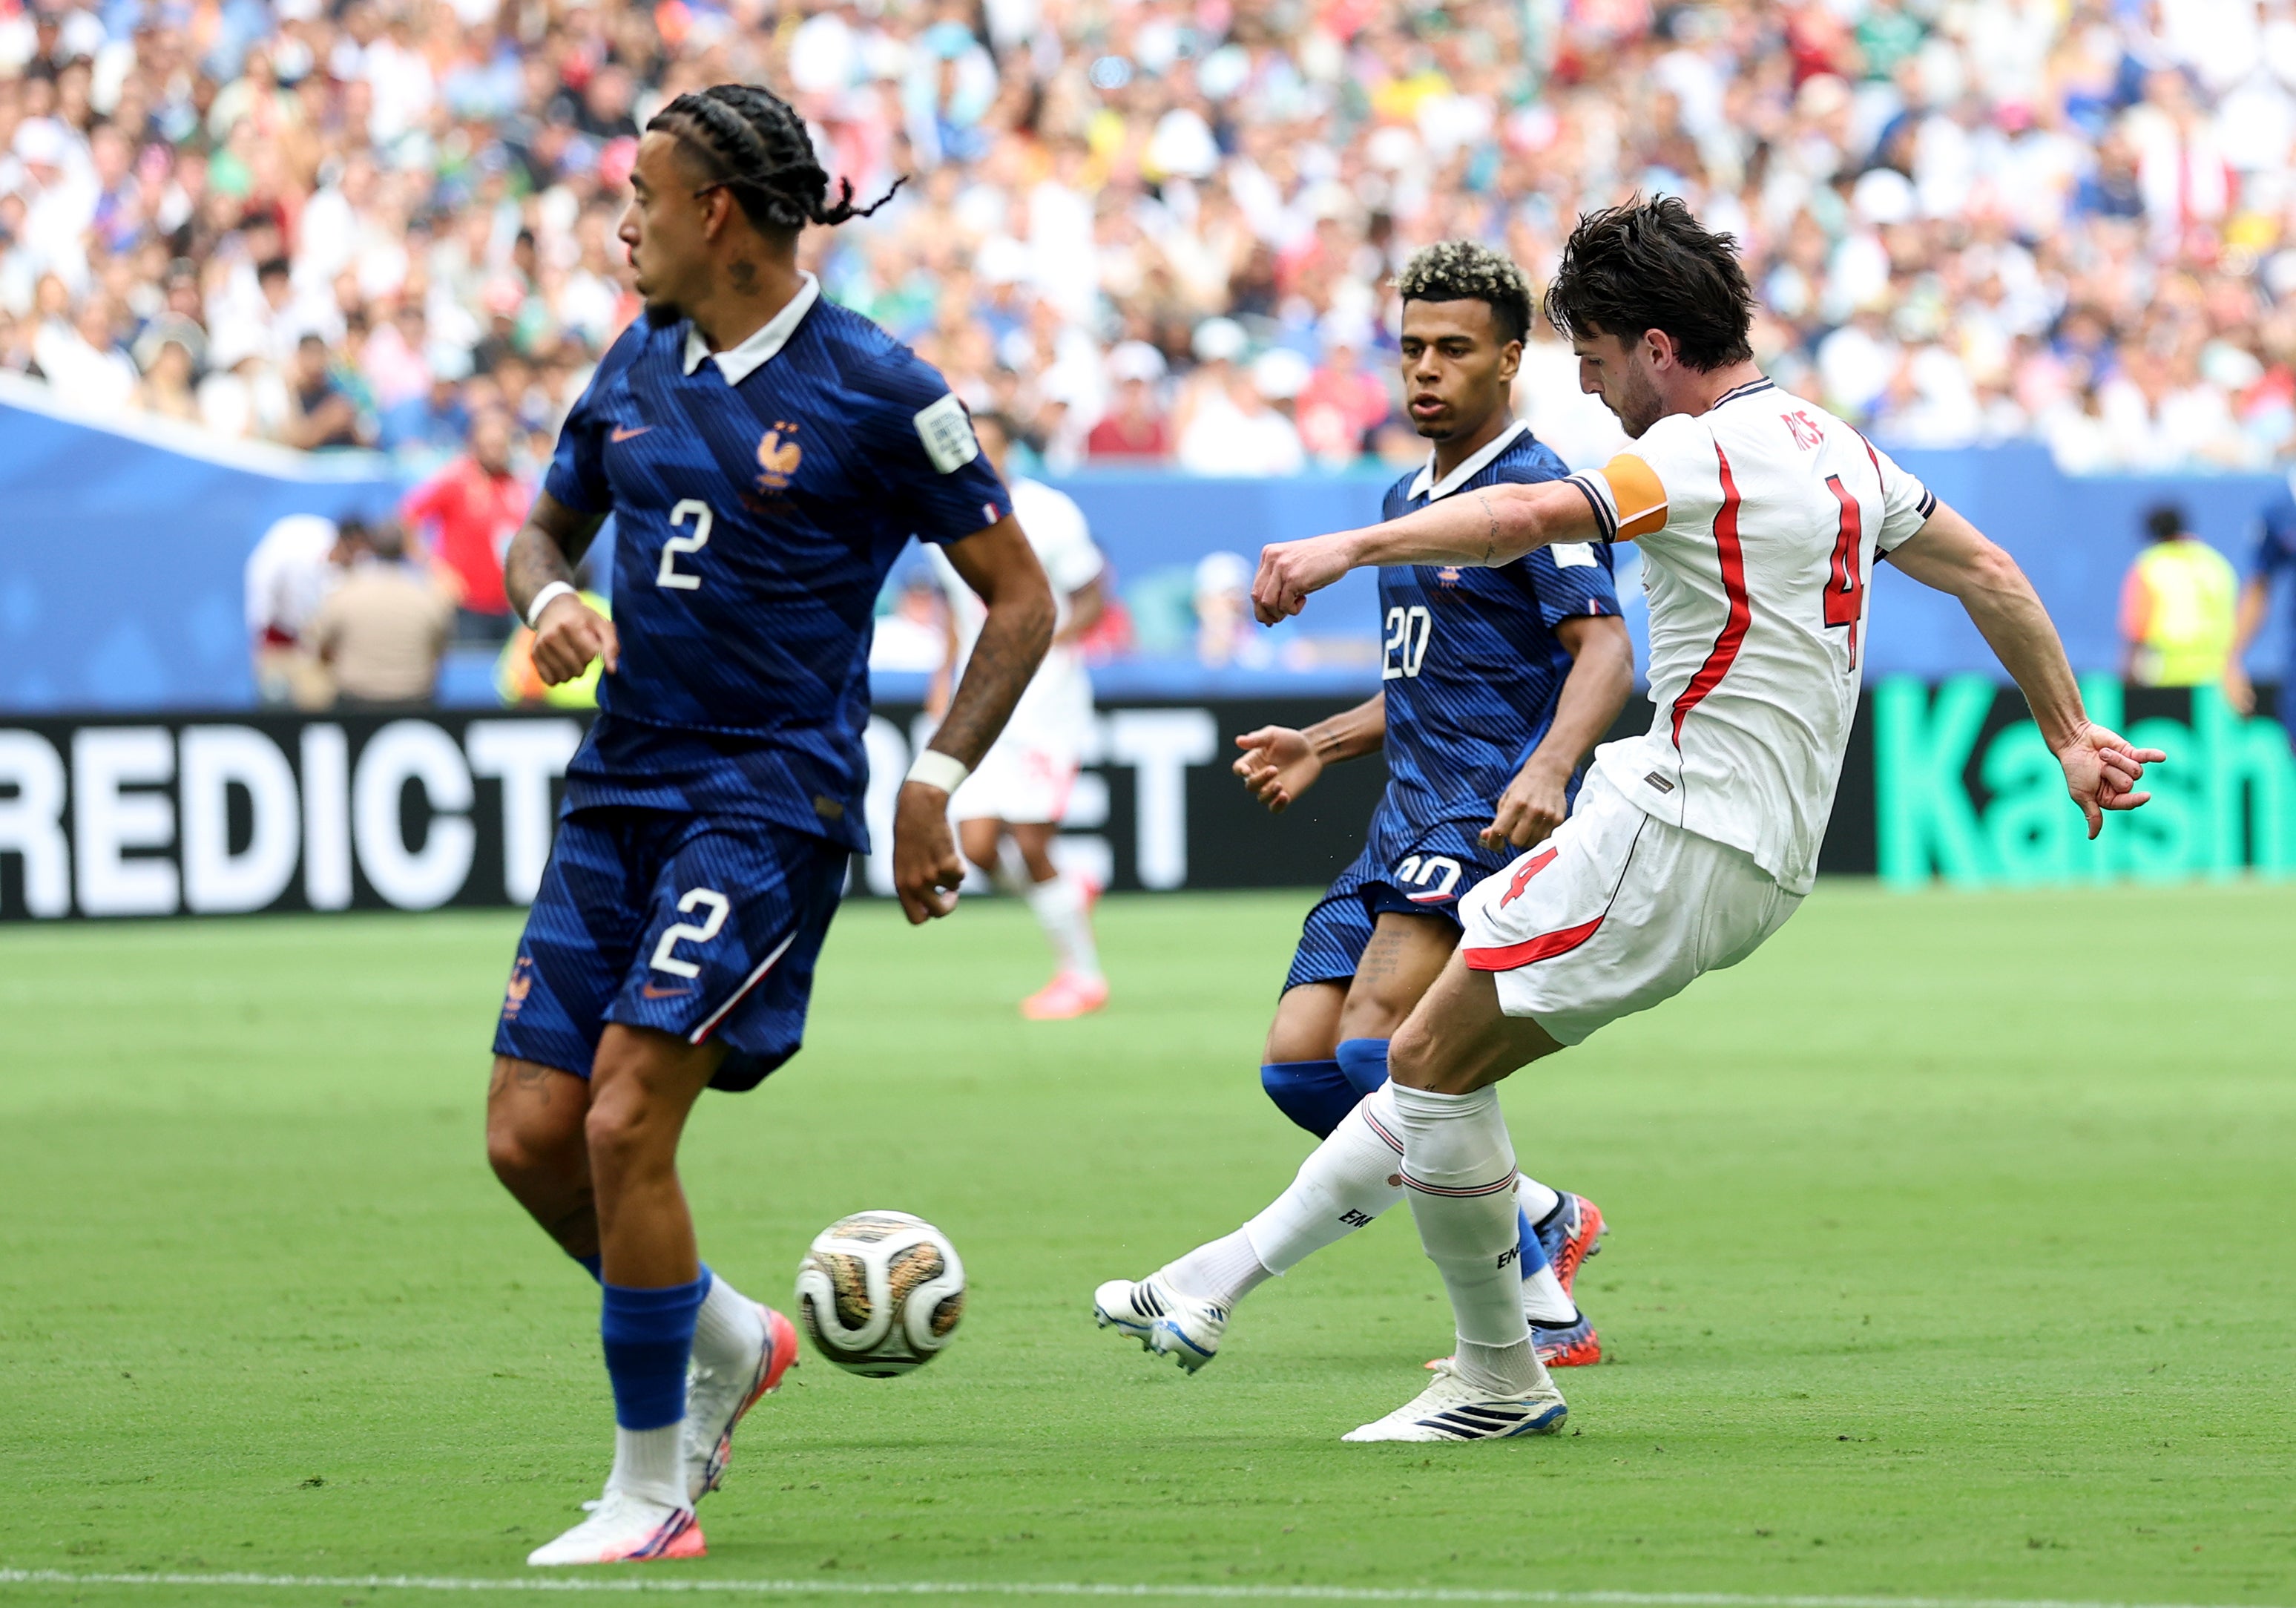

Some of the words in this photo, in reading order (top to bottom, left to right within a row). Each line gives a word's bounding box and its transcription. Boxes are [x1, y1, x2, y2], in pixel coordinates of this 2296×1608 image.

[655, 498, 714, 591] 2
[1823, 473, 1865, 672] 4
[1382, 606, 1432, 680] 20
[1500, 845, 1559, 911] 4
[649, 886, 731, 979] 2
